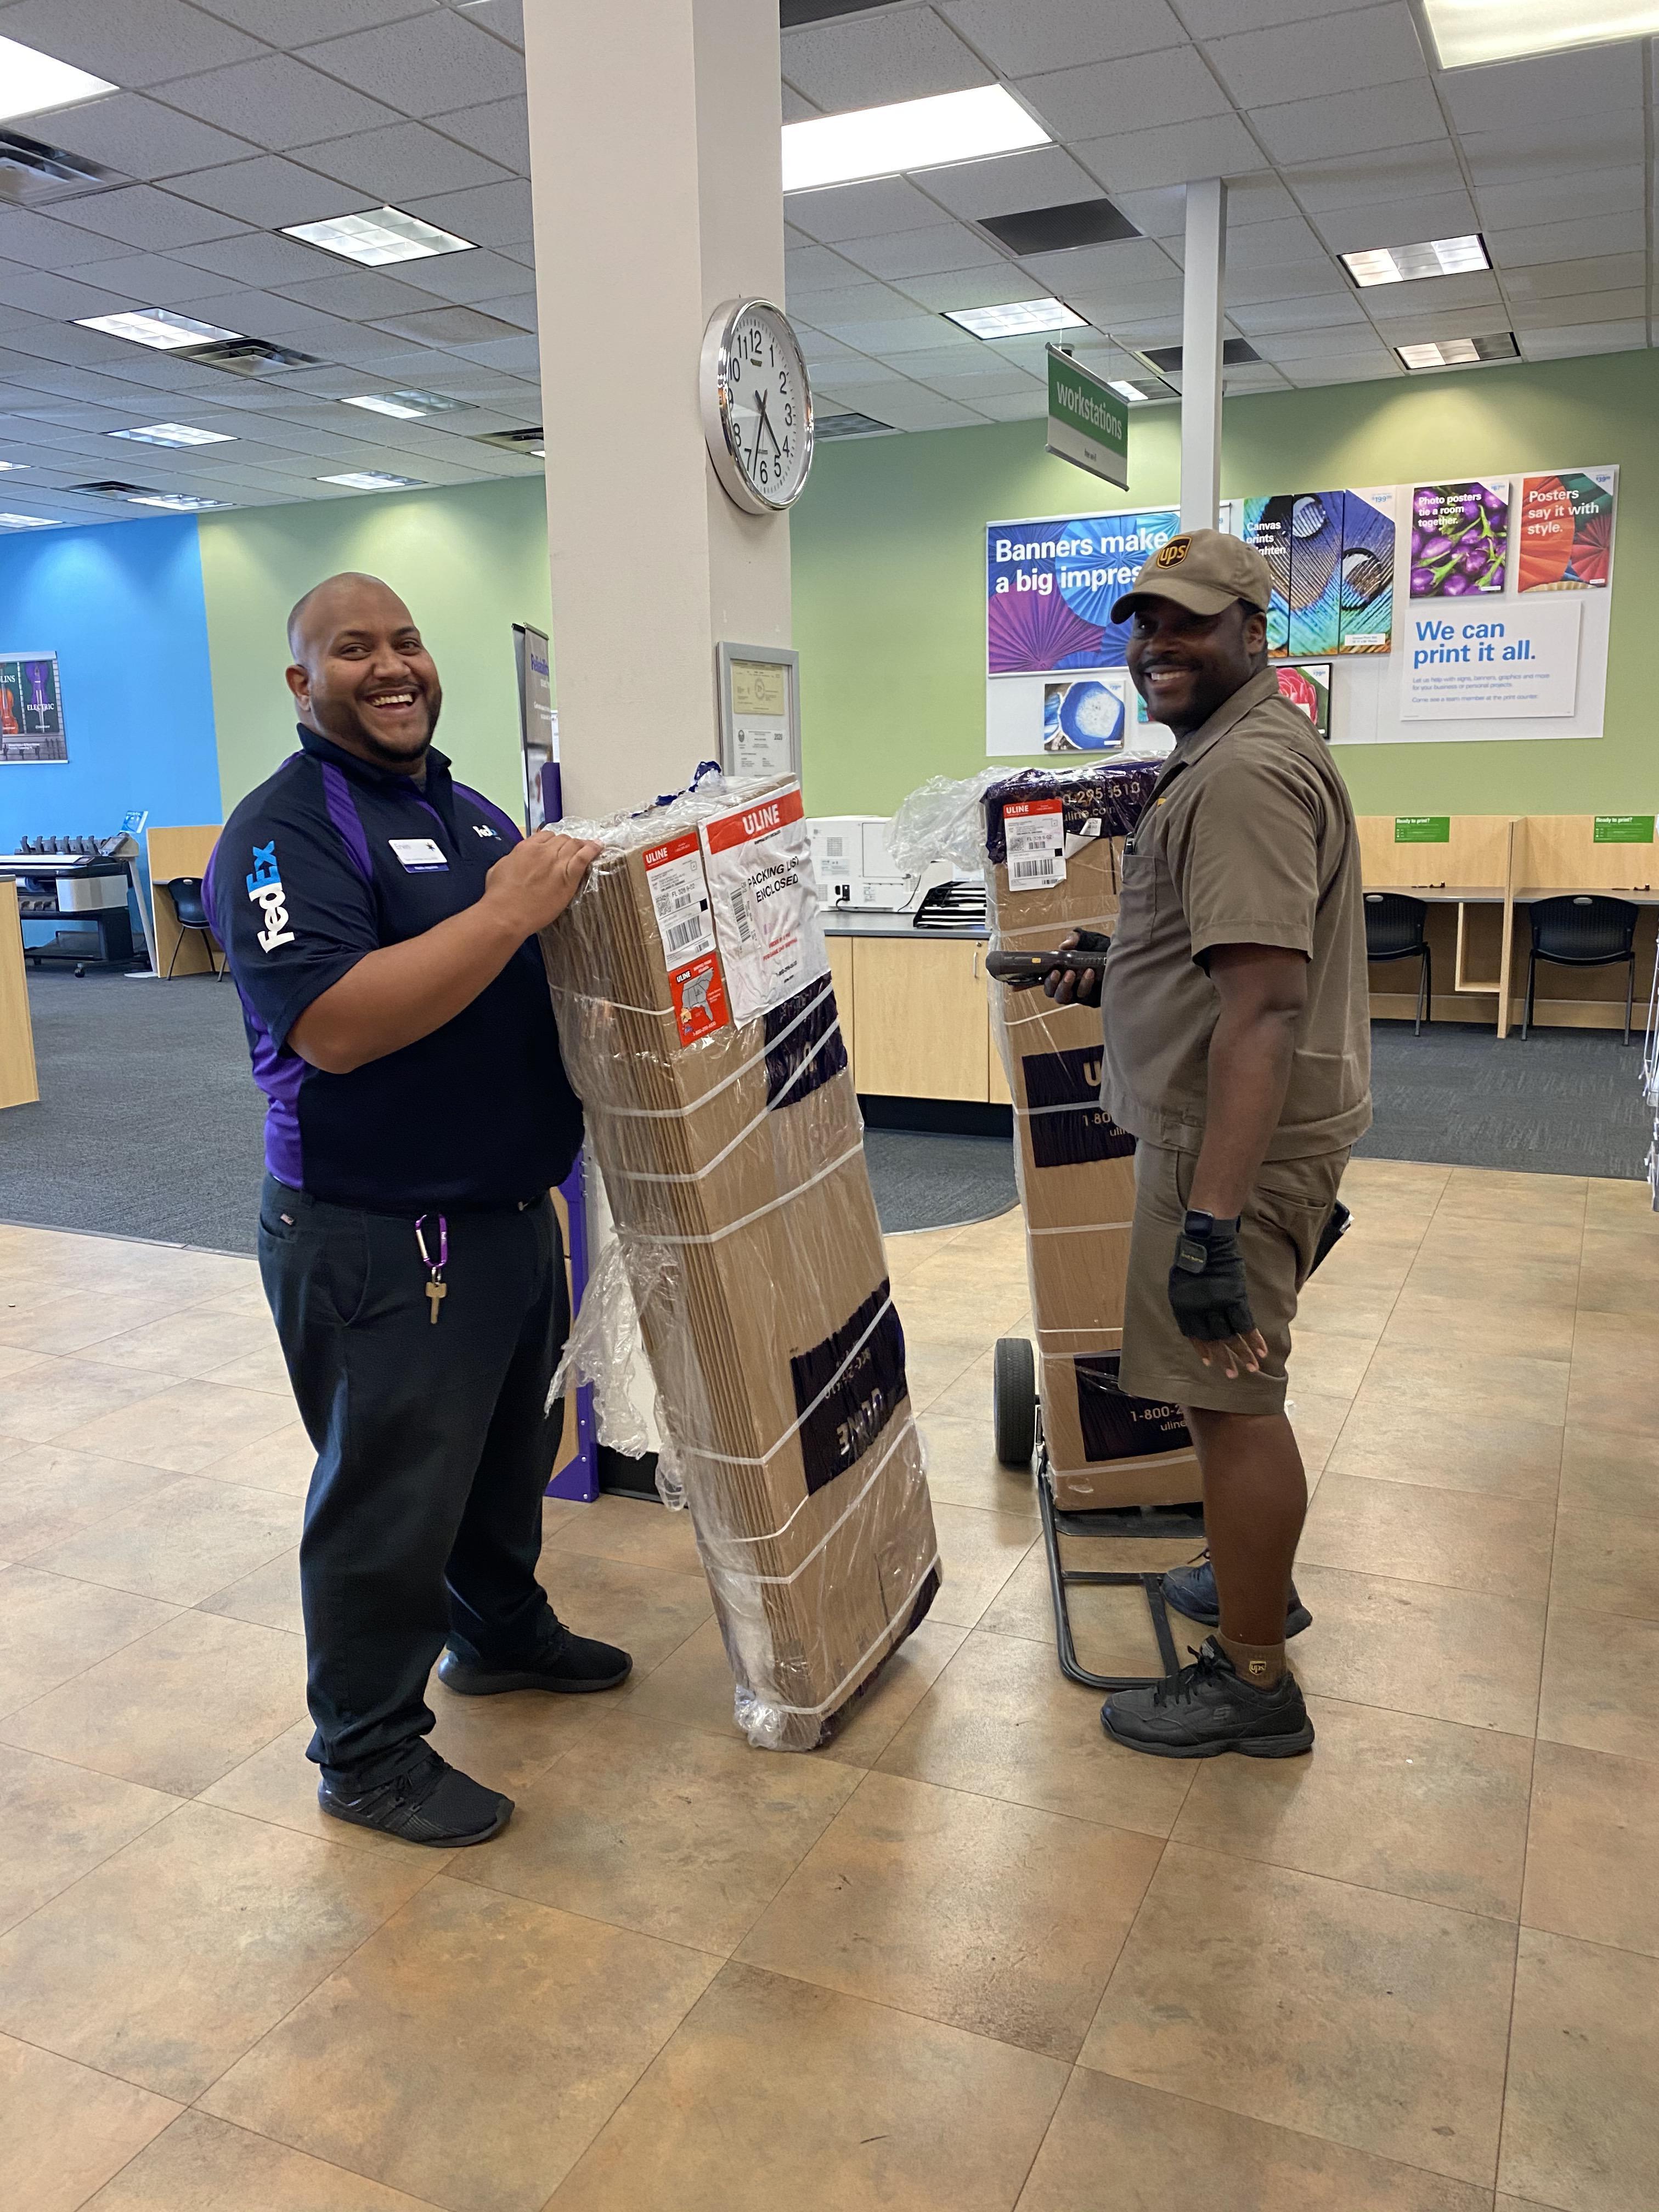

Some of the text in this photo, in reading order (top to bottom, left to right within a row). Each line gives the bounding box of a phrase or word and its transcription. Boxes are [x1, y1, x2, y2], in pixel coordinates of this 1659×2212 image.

[737, 335, 747, 359] 11
[750, 329, 762, 354] 12
[730, 358, 740, 382] 10
[780, 371, 787, 394] 2
[785, 403, 792, 426] 3
[1057, 381, 1122, 439] workstations
[733, 423, 741, 447] 8
[782, 436, 789, 458] 4
[744, 448, 752, 471] 7
[774, 455, 781, 477] 5
[760, 461, 768, 483] 6
[1419, 494, 1481, 505] Photo posters
[1529, 490, 1579, 503] Posters
[1440, 506, 1464, 514] room
[1528, 502, 1599, 520] say it with
[1247, 522, 1281, 531] Canvas
[1418, 517, 1458, 527] together.
[1527, 522, 1563, 536] style.
[996, 527, 1169, 562] Banners make
[1246, 534, 1274, 544] prints
[1160, 545, 1186, 565] ups
[1256, 546, 1286, 556] ghten
[996, 576, 1009, 593] a
[1017, 568, 1053, 595] big
[1416, 621, 1505, 641] We can
[1414, 640, 1535, 669] print it all.
[742, 804, 780, 835] ULINE
[1006, 805, 1029, 814] ULINE
[645, 847, 668, 864] ULINE
[748, 864, 784, 887] PACKING
[246, 840, 295, 953] FedEx
[756, 873, 799, 903] ENCLOSED
[676, 970, 691, 983] ULINE
